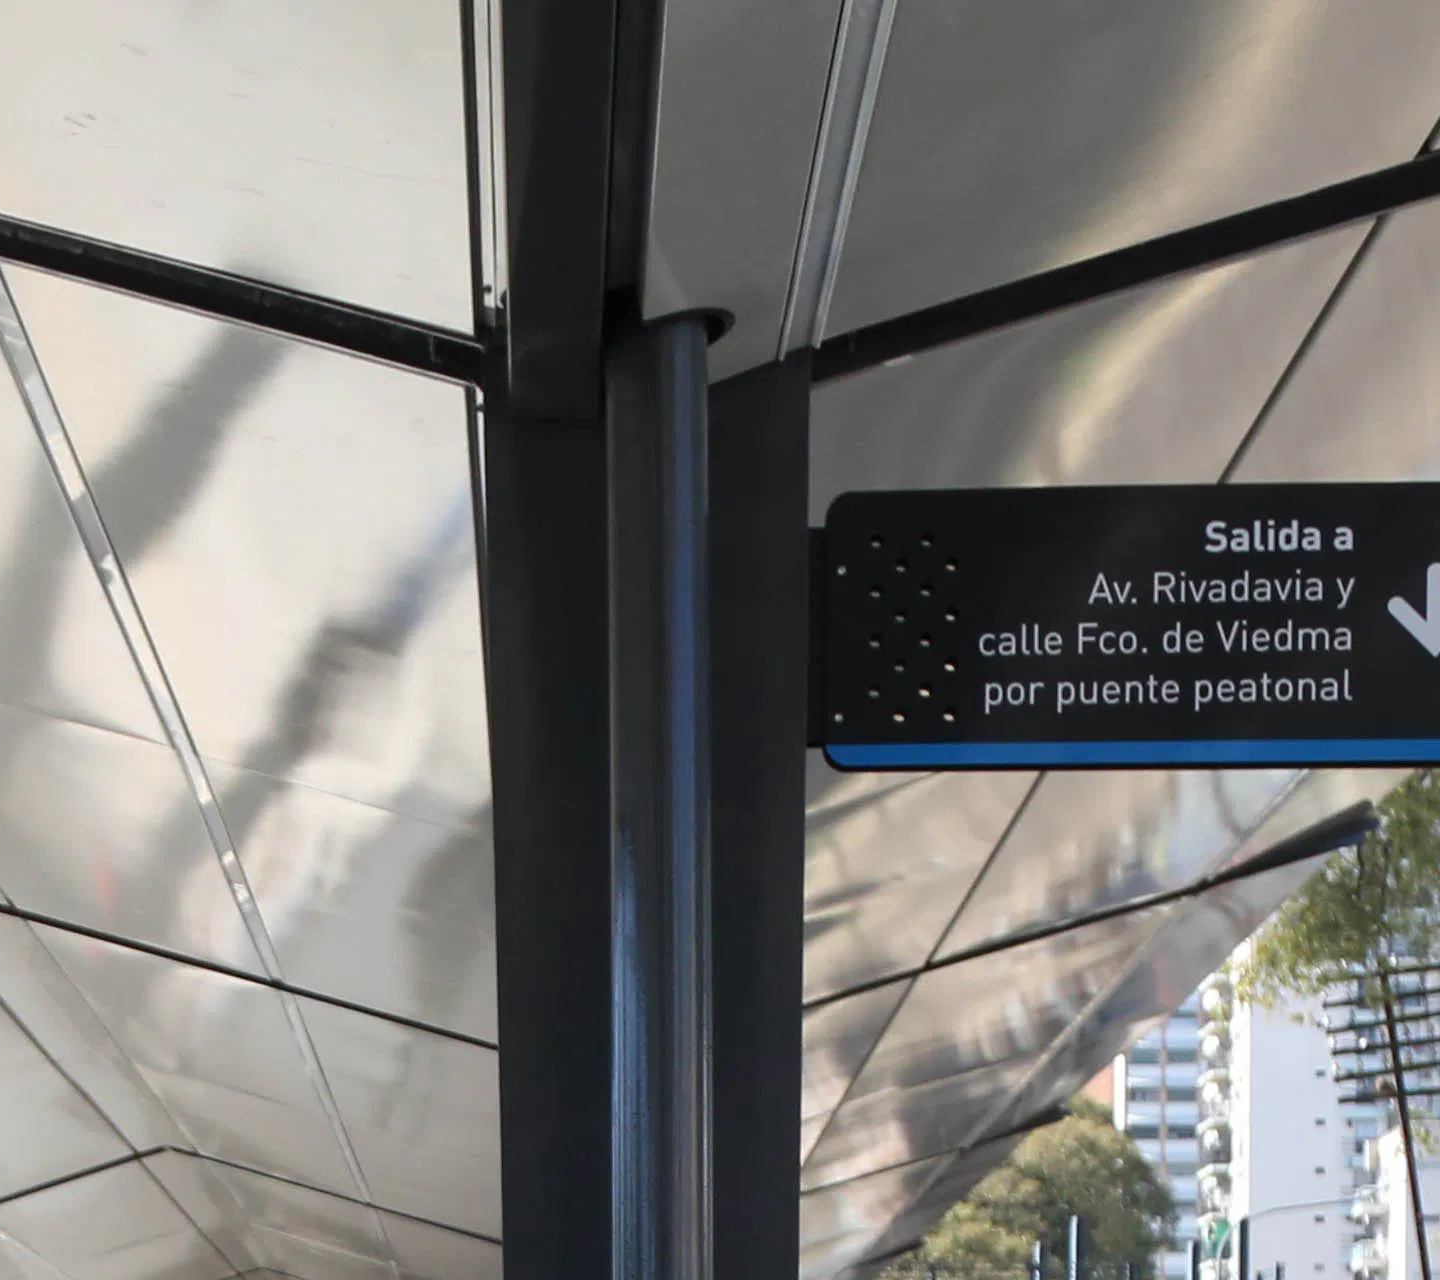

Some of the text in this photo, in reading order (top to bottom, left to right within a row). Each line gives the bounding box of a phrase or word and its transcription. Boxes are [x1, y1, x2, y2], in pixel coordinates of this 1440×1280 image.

[1205, 519, 1354, 553] Salida a
[1088, 568, 1355, 609] Av. Rivadavia y
[979, 619, 1352, 656] calle Fco. de Viedma
[984, 668, 1353, 715] por puente peatonal
